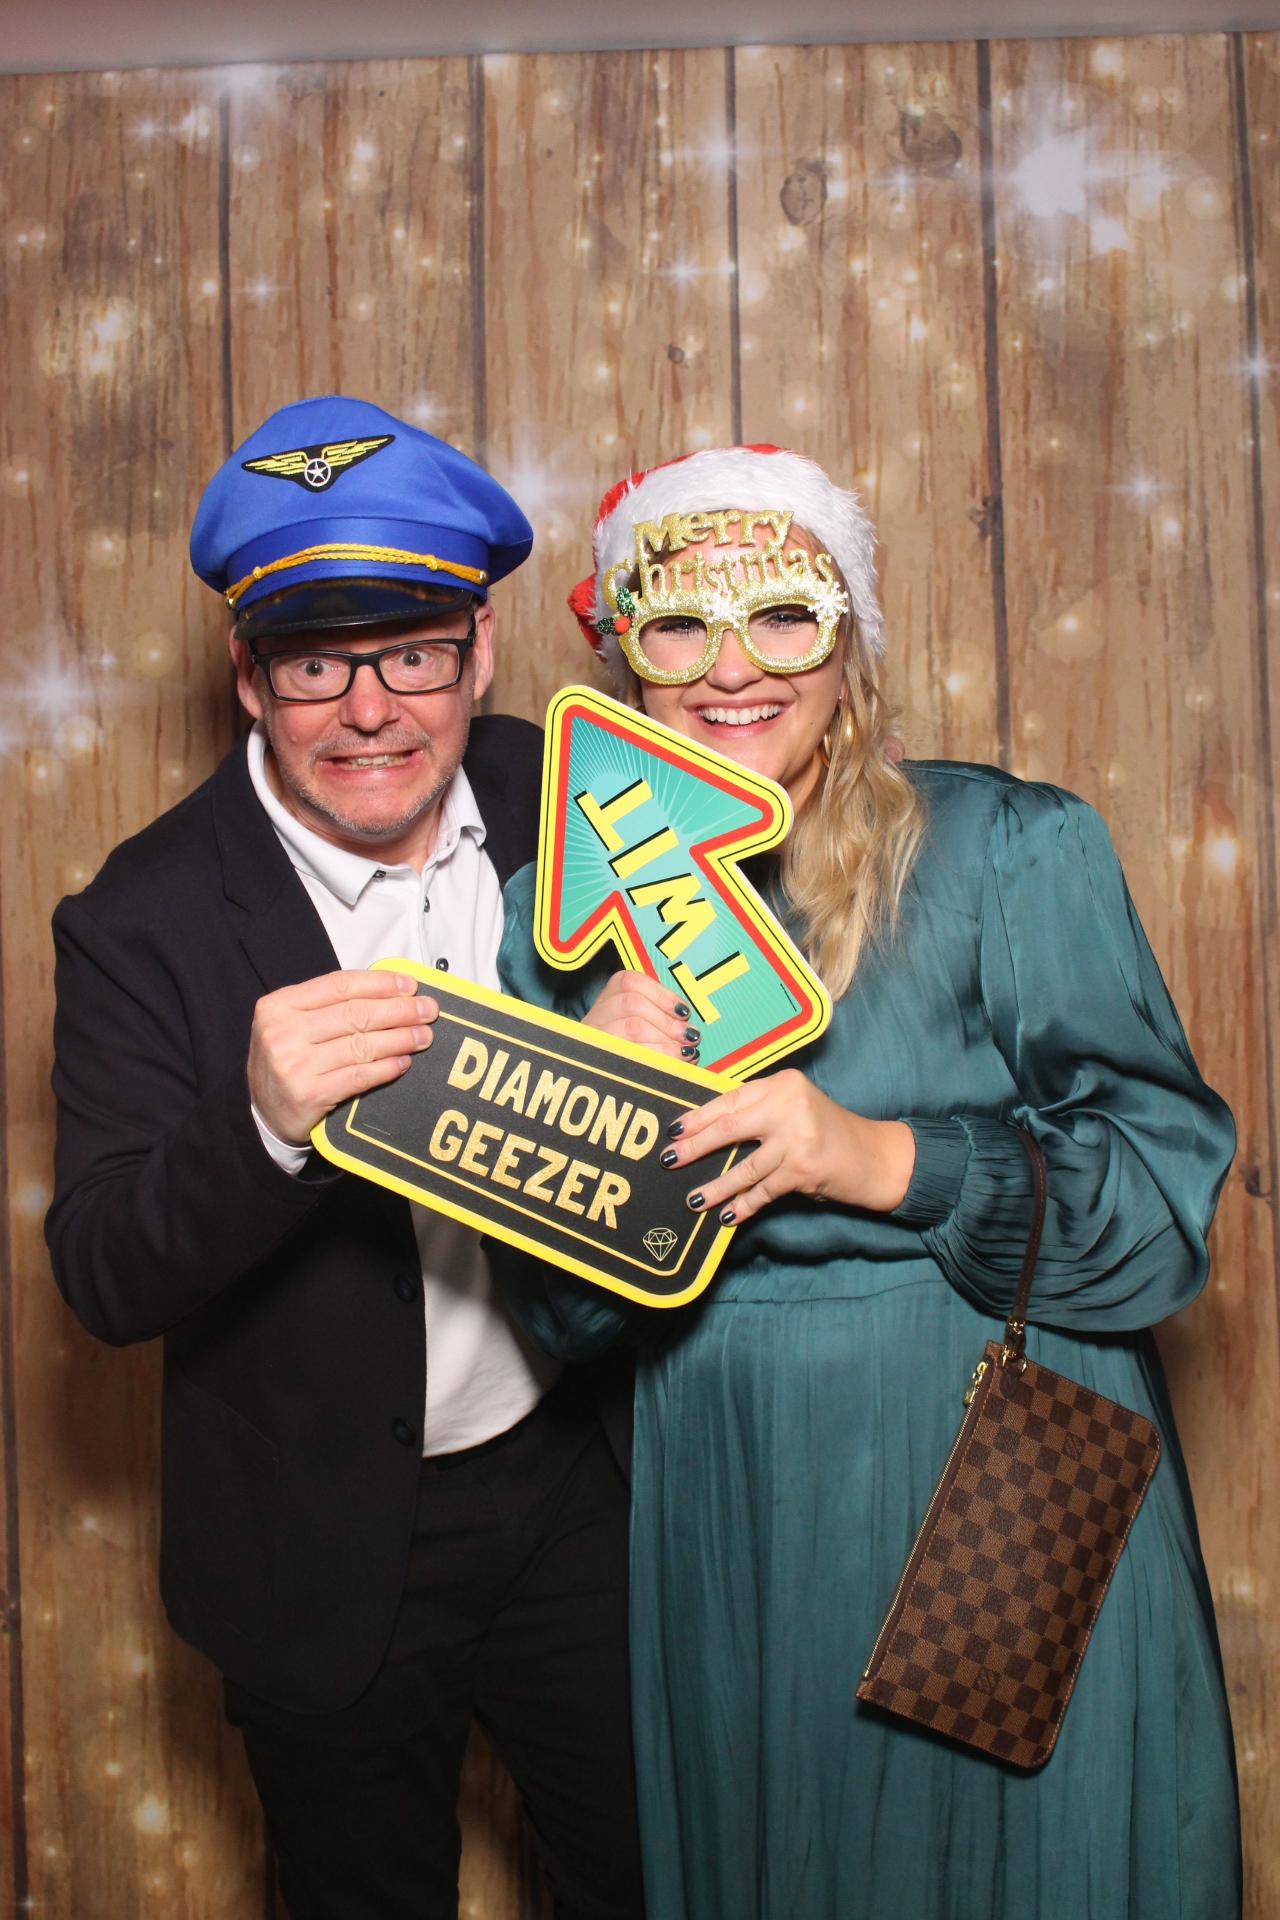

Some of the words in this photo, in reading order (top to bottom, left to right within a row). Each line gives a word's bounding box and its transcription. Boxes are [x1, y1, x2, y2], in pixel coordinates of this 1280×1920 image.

[632, 510, 794, 555] Merry
[447, 1037, 660, 1161] DIAMOND
[428, 1109, 631, 1230] GEEZER
